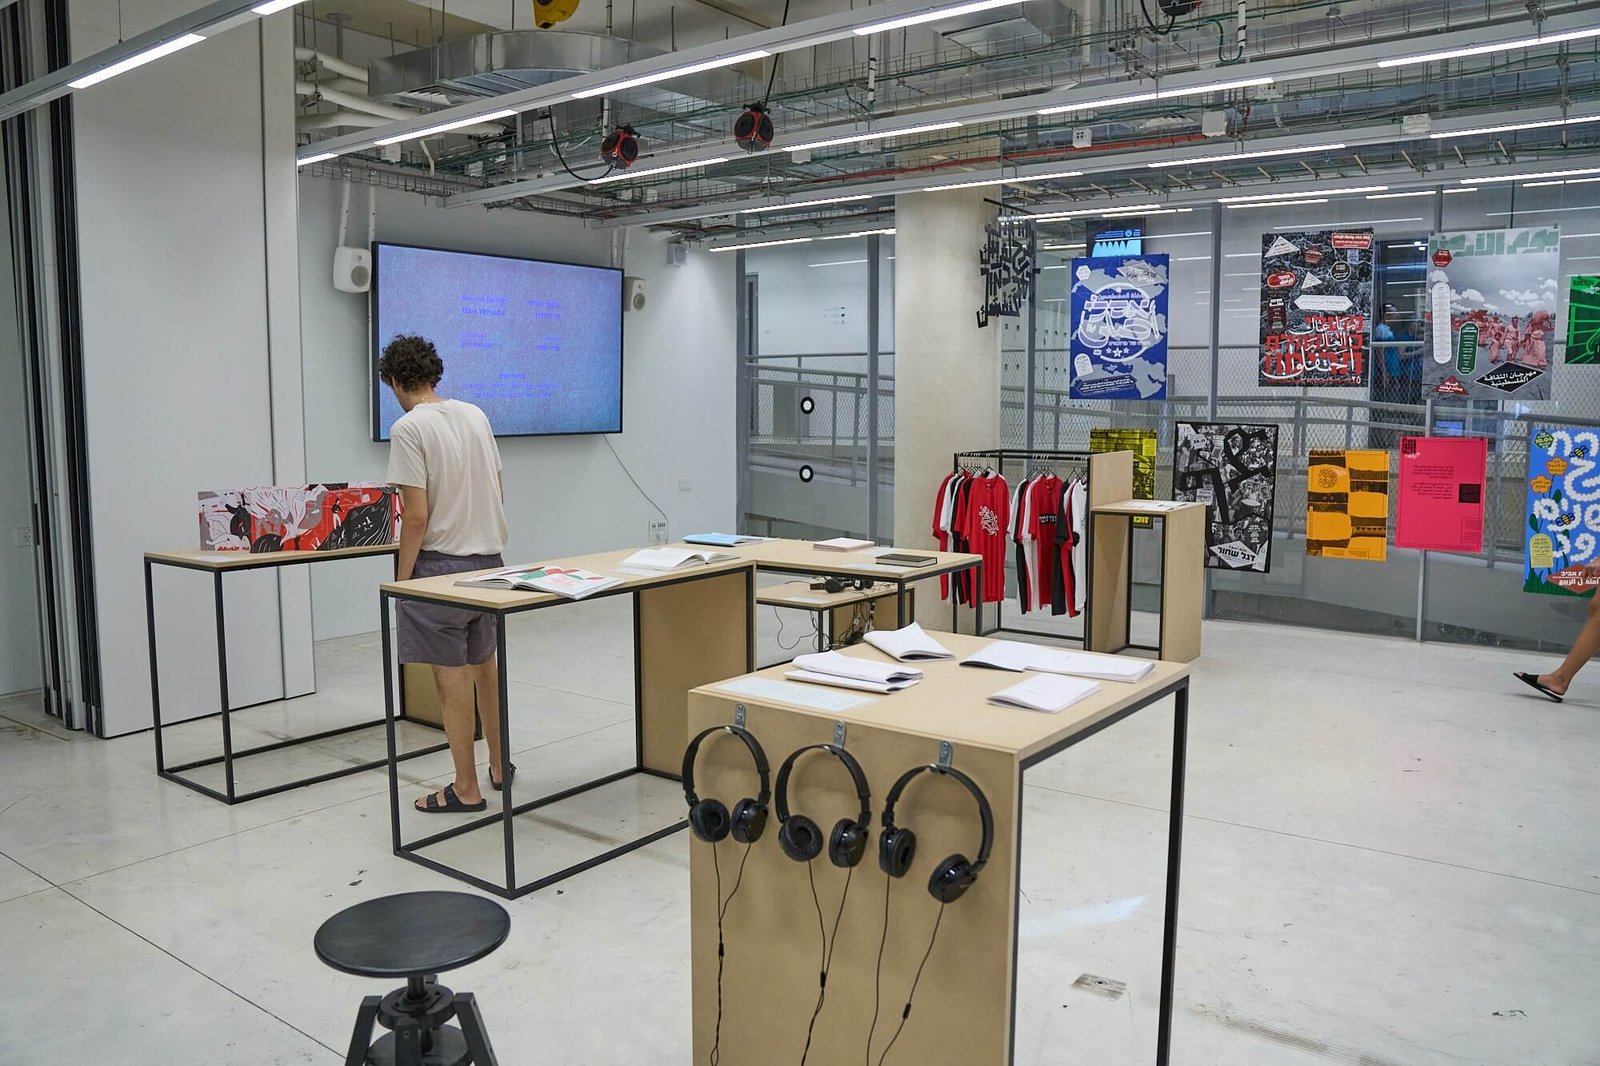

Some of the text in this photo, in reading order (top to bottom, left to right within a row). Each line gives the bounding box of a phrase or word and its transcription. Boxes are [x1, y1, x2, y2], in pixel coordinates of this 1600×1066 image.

[1509, 370, 1537, 379] مهرجان
[1218, 546, 1255, 562] דגל שחור
